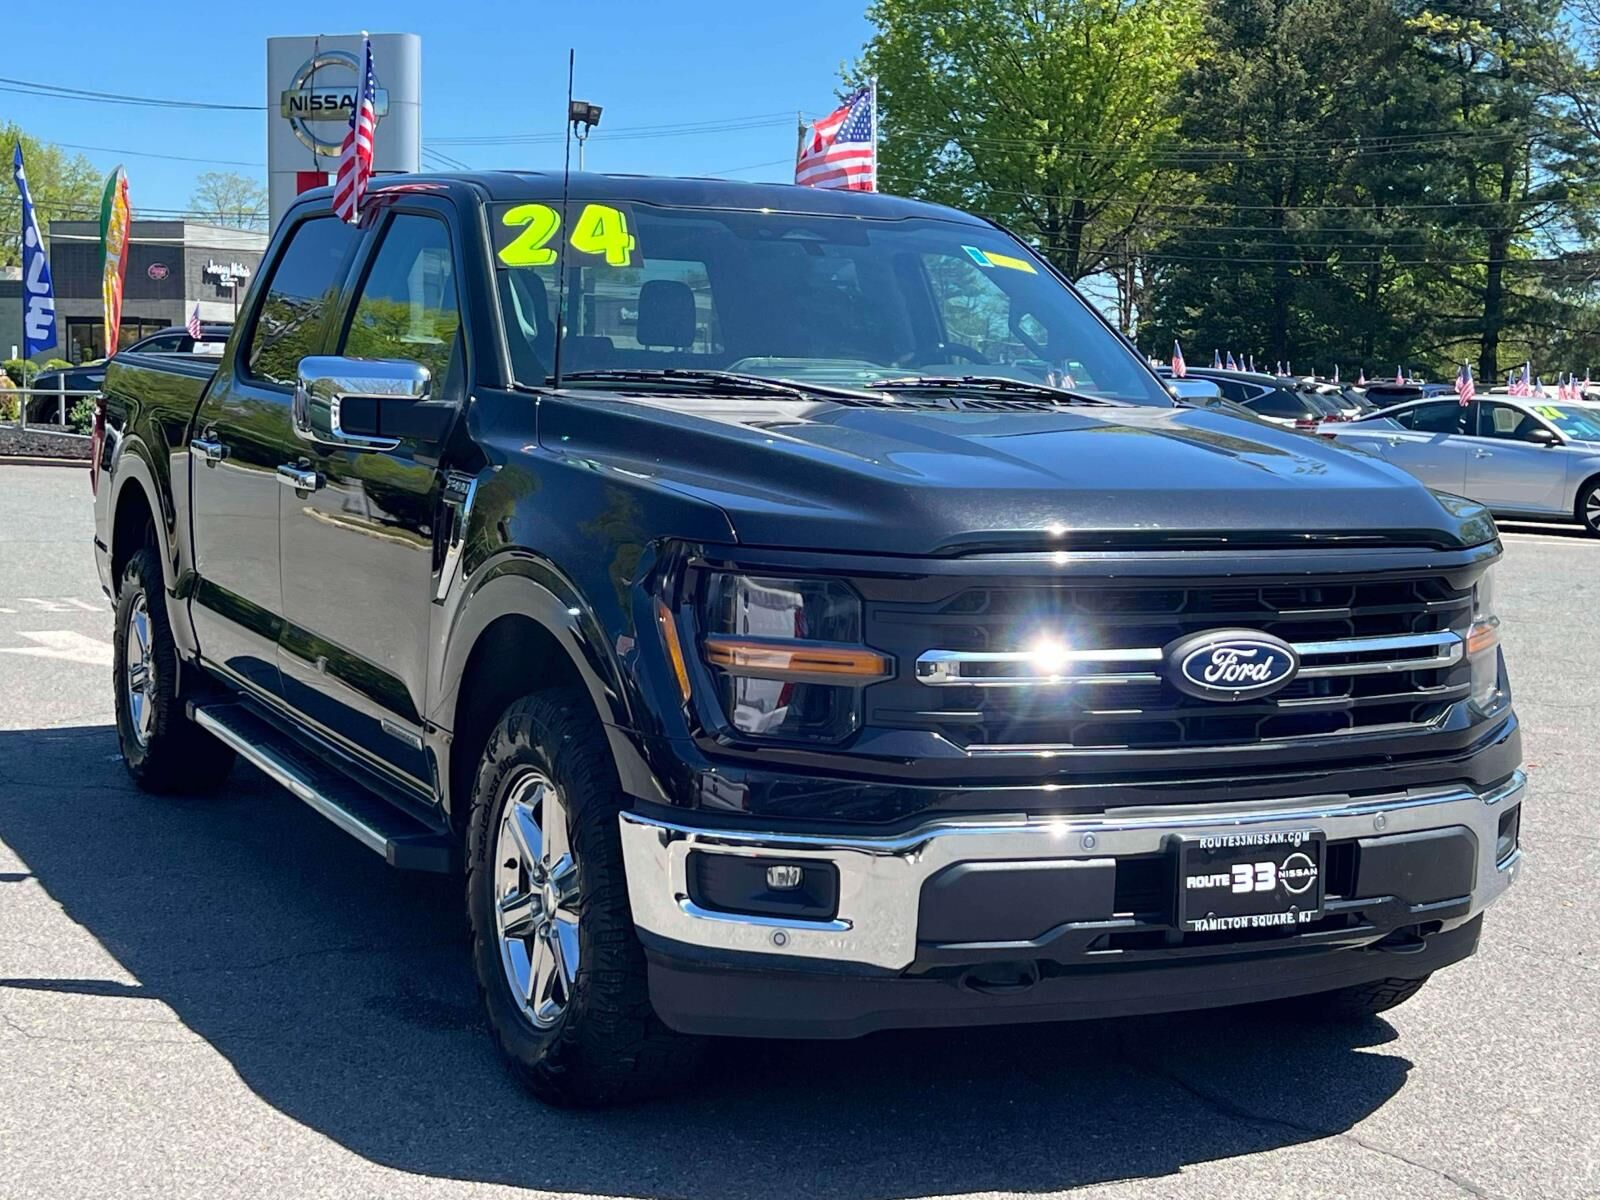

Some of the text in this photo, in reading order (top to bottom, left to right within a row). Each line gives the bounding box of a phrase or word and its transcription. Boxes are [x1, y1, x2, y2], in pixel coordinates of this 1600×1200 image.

[289, 94, 354, 111] NISSA
[498, 203, 635, 267] 24
[1204, 648, 1274, 682] Ford
[1200, 831, 1310, 849] ROUTE33NISSAN.COM
[1186, 861, 1276, 894] ROUTE 33
[1278, 867, 1318, 878] NISSAN
[1194, 916, 1248, 931] HAMILTON
[1298, 911, 1312, 923] NJ
